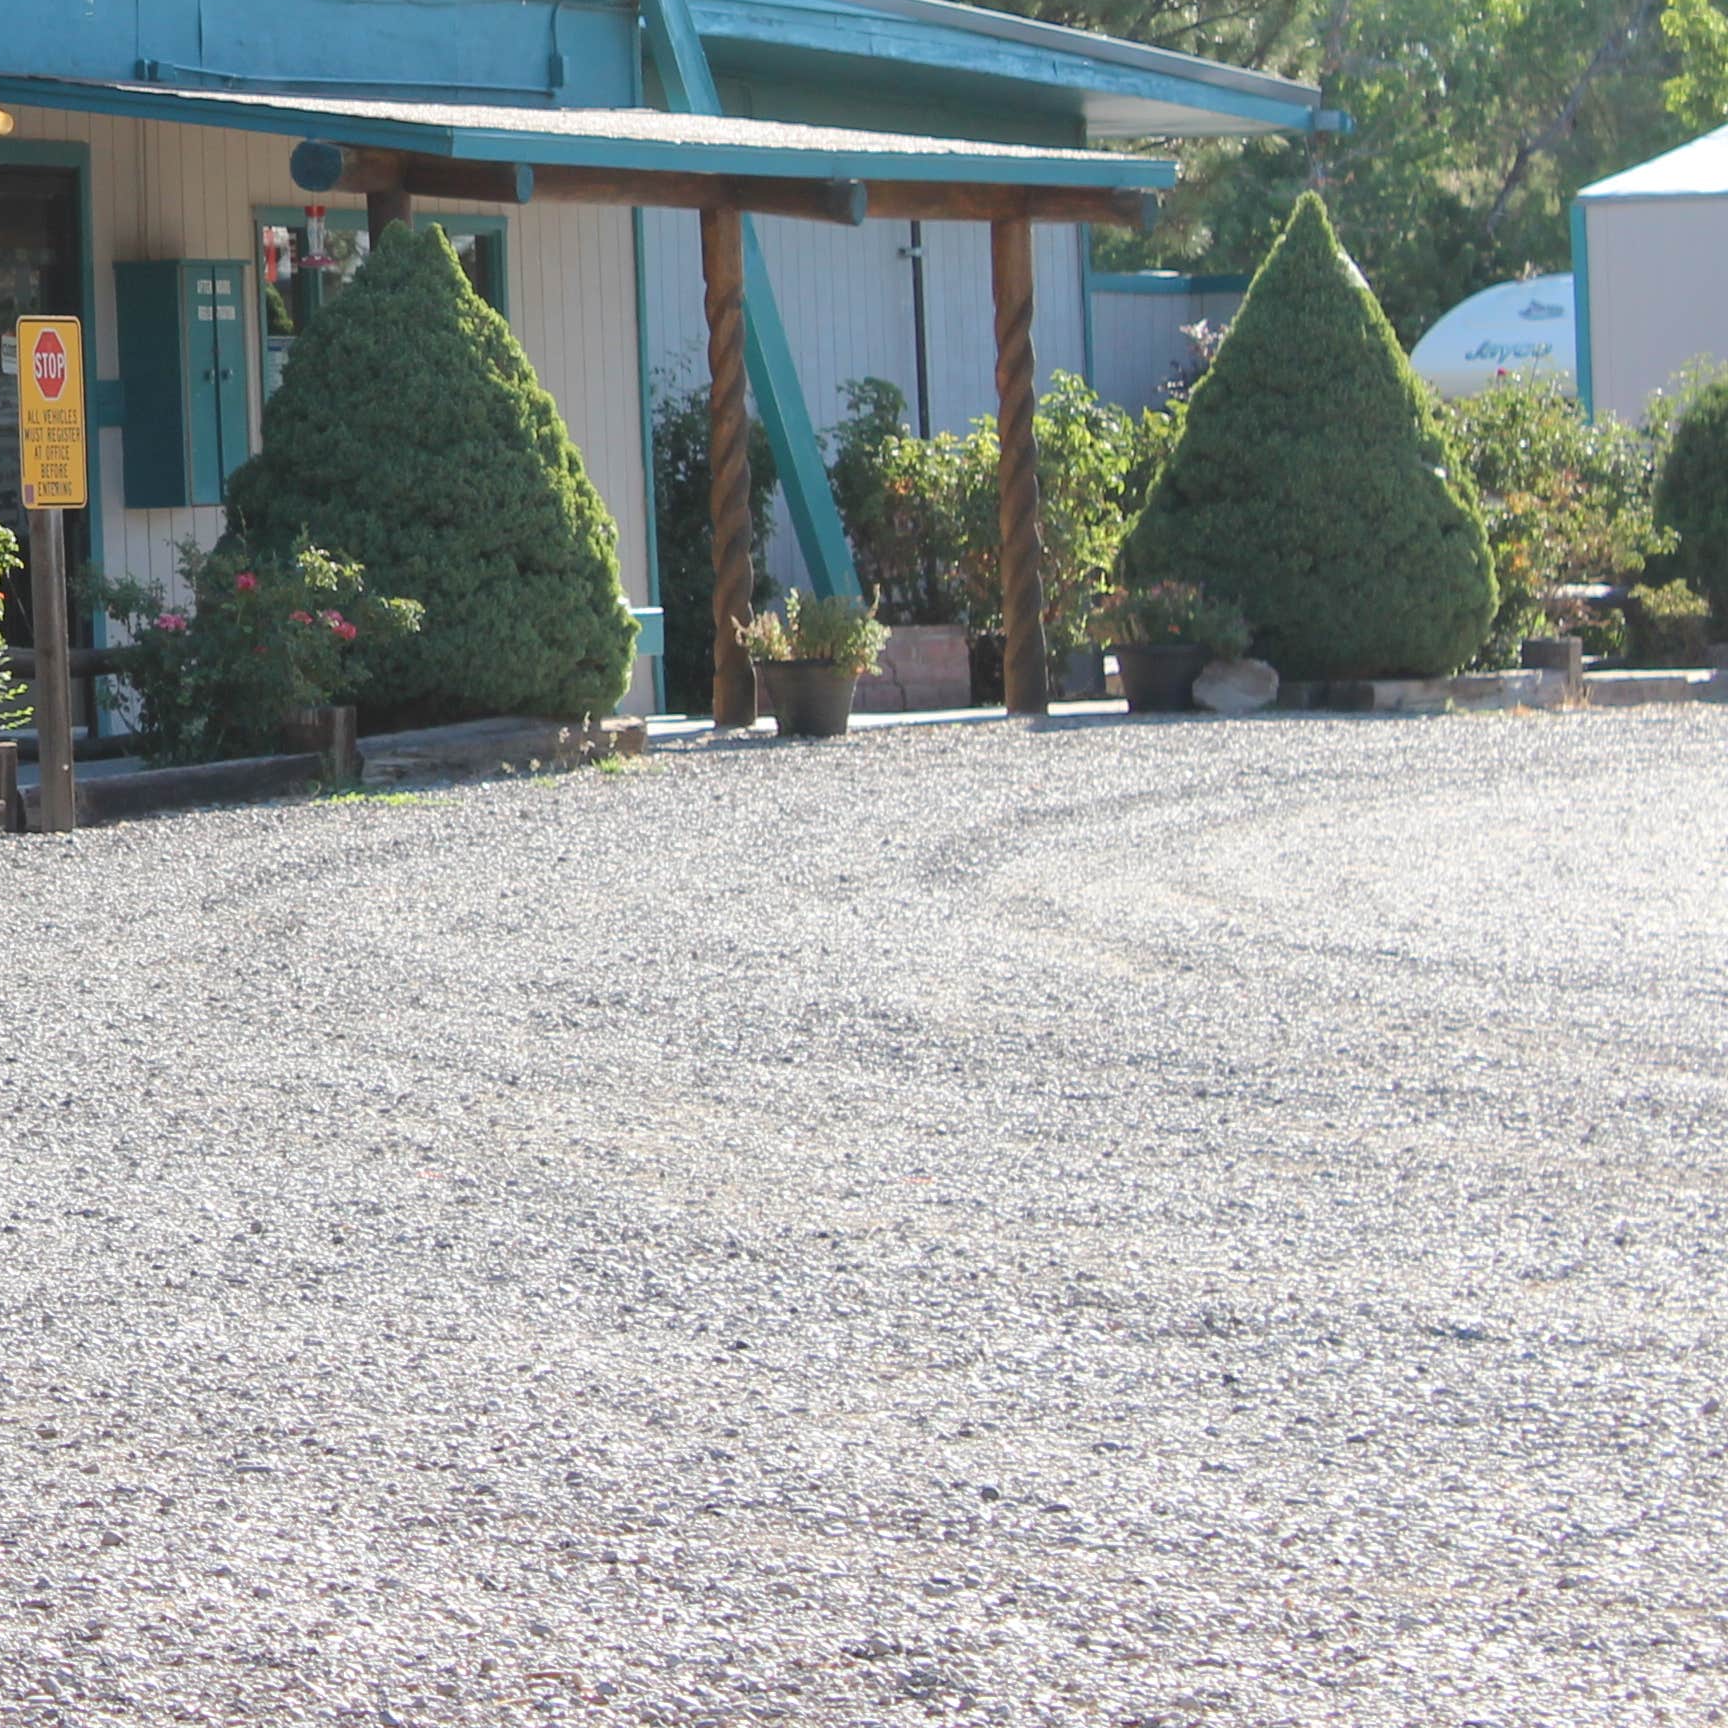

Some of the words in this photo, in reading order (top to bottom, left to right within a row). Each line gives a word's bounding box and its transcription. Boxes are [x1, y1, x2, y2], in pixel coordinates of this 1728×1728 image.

[34, 352, 65, 379] STOP
[27, 409, 40, 424] ALL
[44, 409, 78, 424] VEHICLES
[25, 427, 43, 442] MUST
[47, 427, 81, 442] REGISTER
[34, 445, 42, 460] AT
[46, 445, 70, 460] OFFICE
[41, 463, 69, 479] BEFORE
[38, 481, 73, 497] ENTERING
